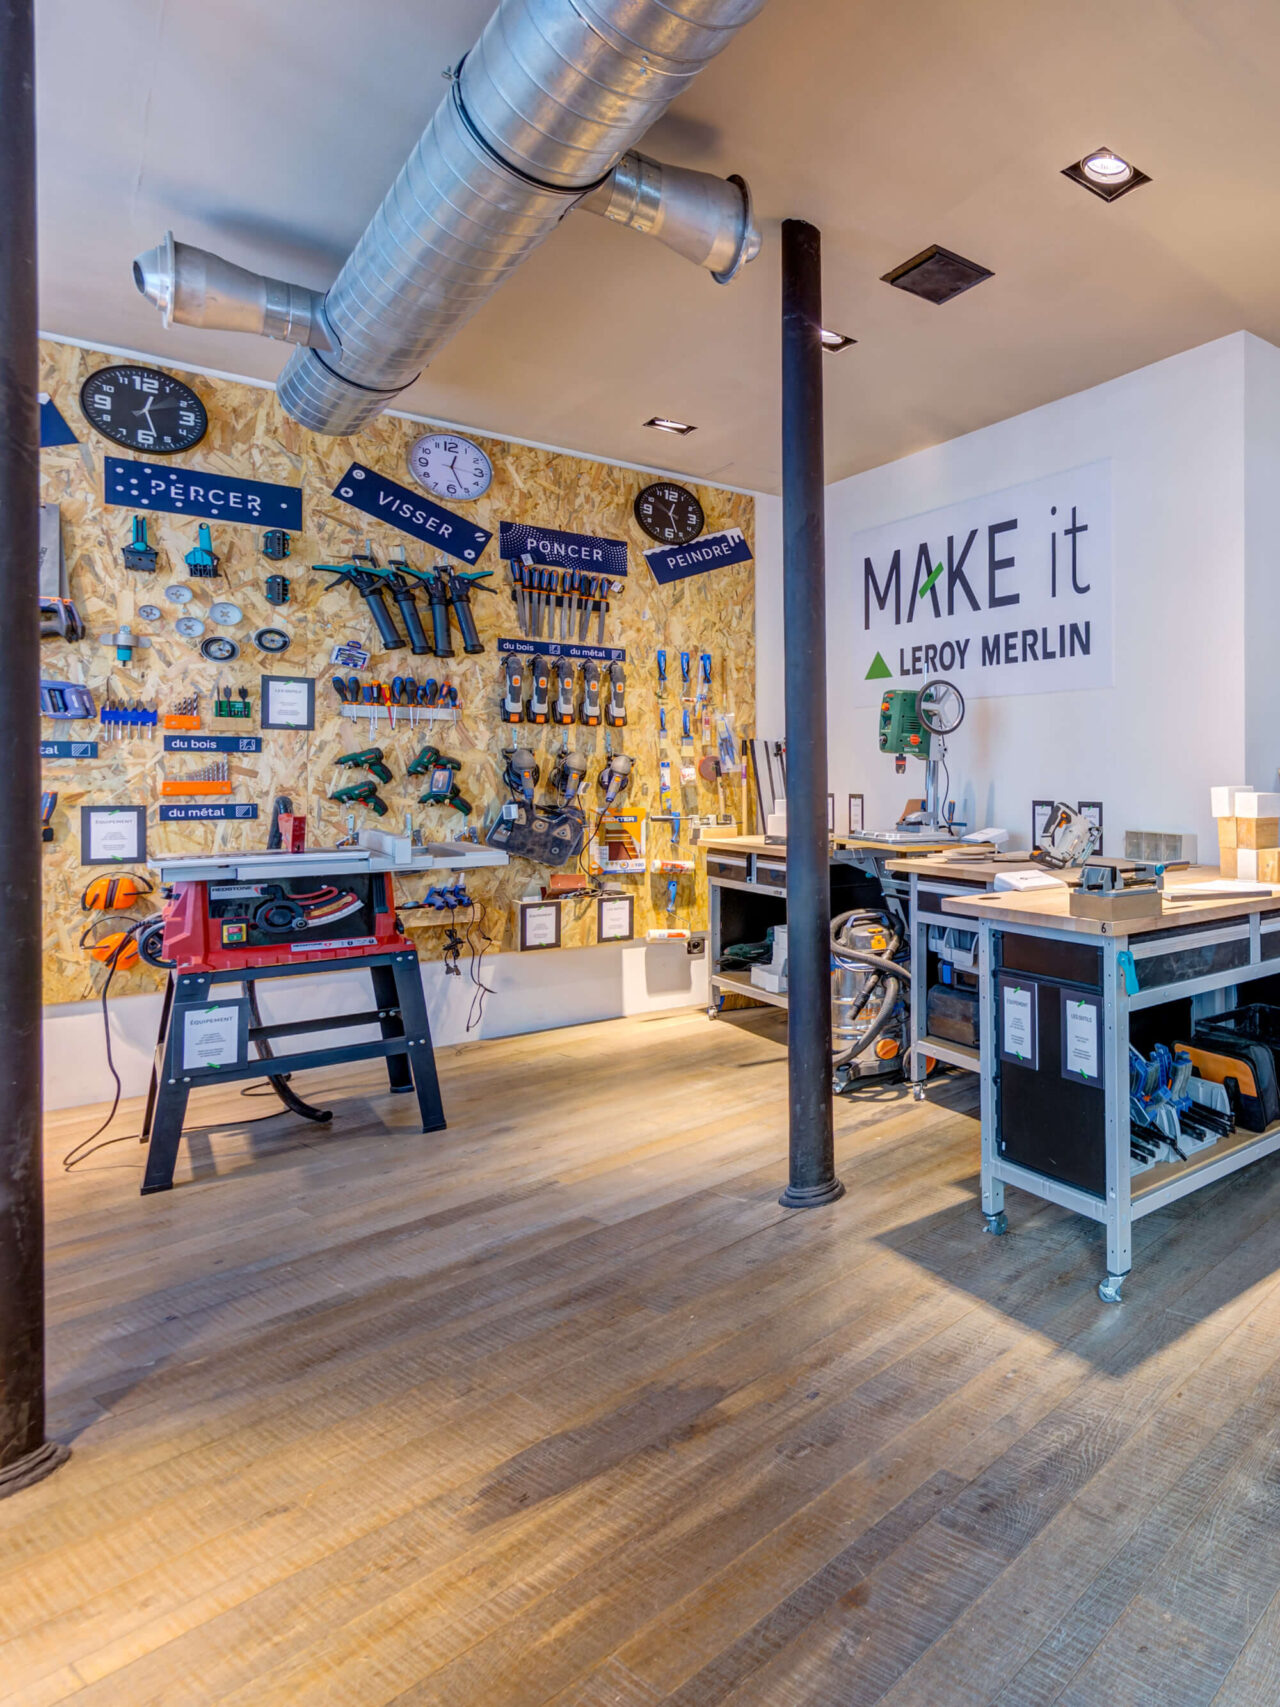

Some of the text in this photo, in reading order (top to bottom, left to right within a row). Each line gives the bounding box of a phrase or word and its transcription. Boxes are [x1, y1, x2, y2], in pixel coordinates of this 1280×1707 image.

[119, 376, 129, 384] 11
[132, 375, 159, 394] 12
[101, 384, 115, 393] 10
[164, 386, 171, 394] 1
[93, 393, 112, 411] 9
[178, 410, 196, 427] 3
[118, 427, 127, 437] 7
[136, 429, 155, 445] 6
[422, 447, 432, 455] 10
[443, 441, 459, 454] 12
[418, 457, 429, 467] 9
[472, 457, 480, 465] 2
[473, 467, 485, 478] 3
[432, 482, 439, 490] 7
[446, 484, 457, 495] 6
[151, 479, 262, 512] PERCER
[664, 489, 679, 502] 12
[379, 490, 453, 539] VISSER
[642, 503, 653, 515] 9
[687, 513, 697, 525] 3
[664, 527, 674, 538] 6
[527, 538, 603, 562] PONCER
[666, 542, 732, 570] PEINDRE
[864, 505, 1091, 631] MAKE it
[503, 640, 534, 653] du bois
[569, 646, 606, 659] du métal
[900, 620, 1091, 677] LEROY MERLIN
[171, 739, 217, 749] du bois
[168, 807, 226, 818] du métal
[1101, 922, 1107, 934] 6
